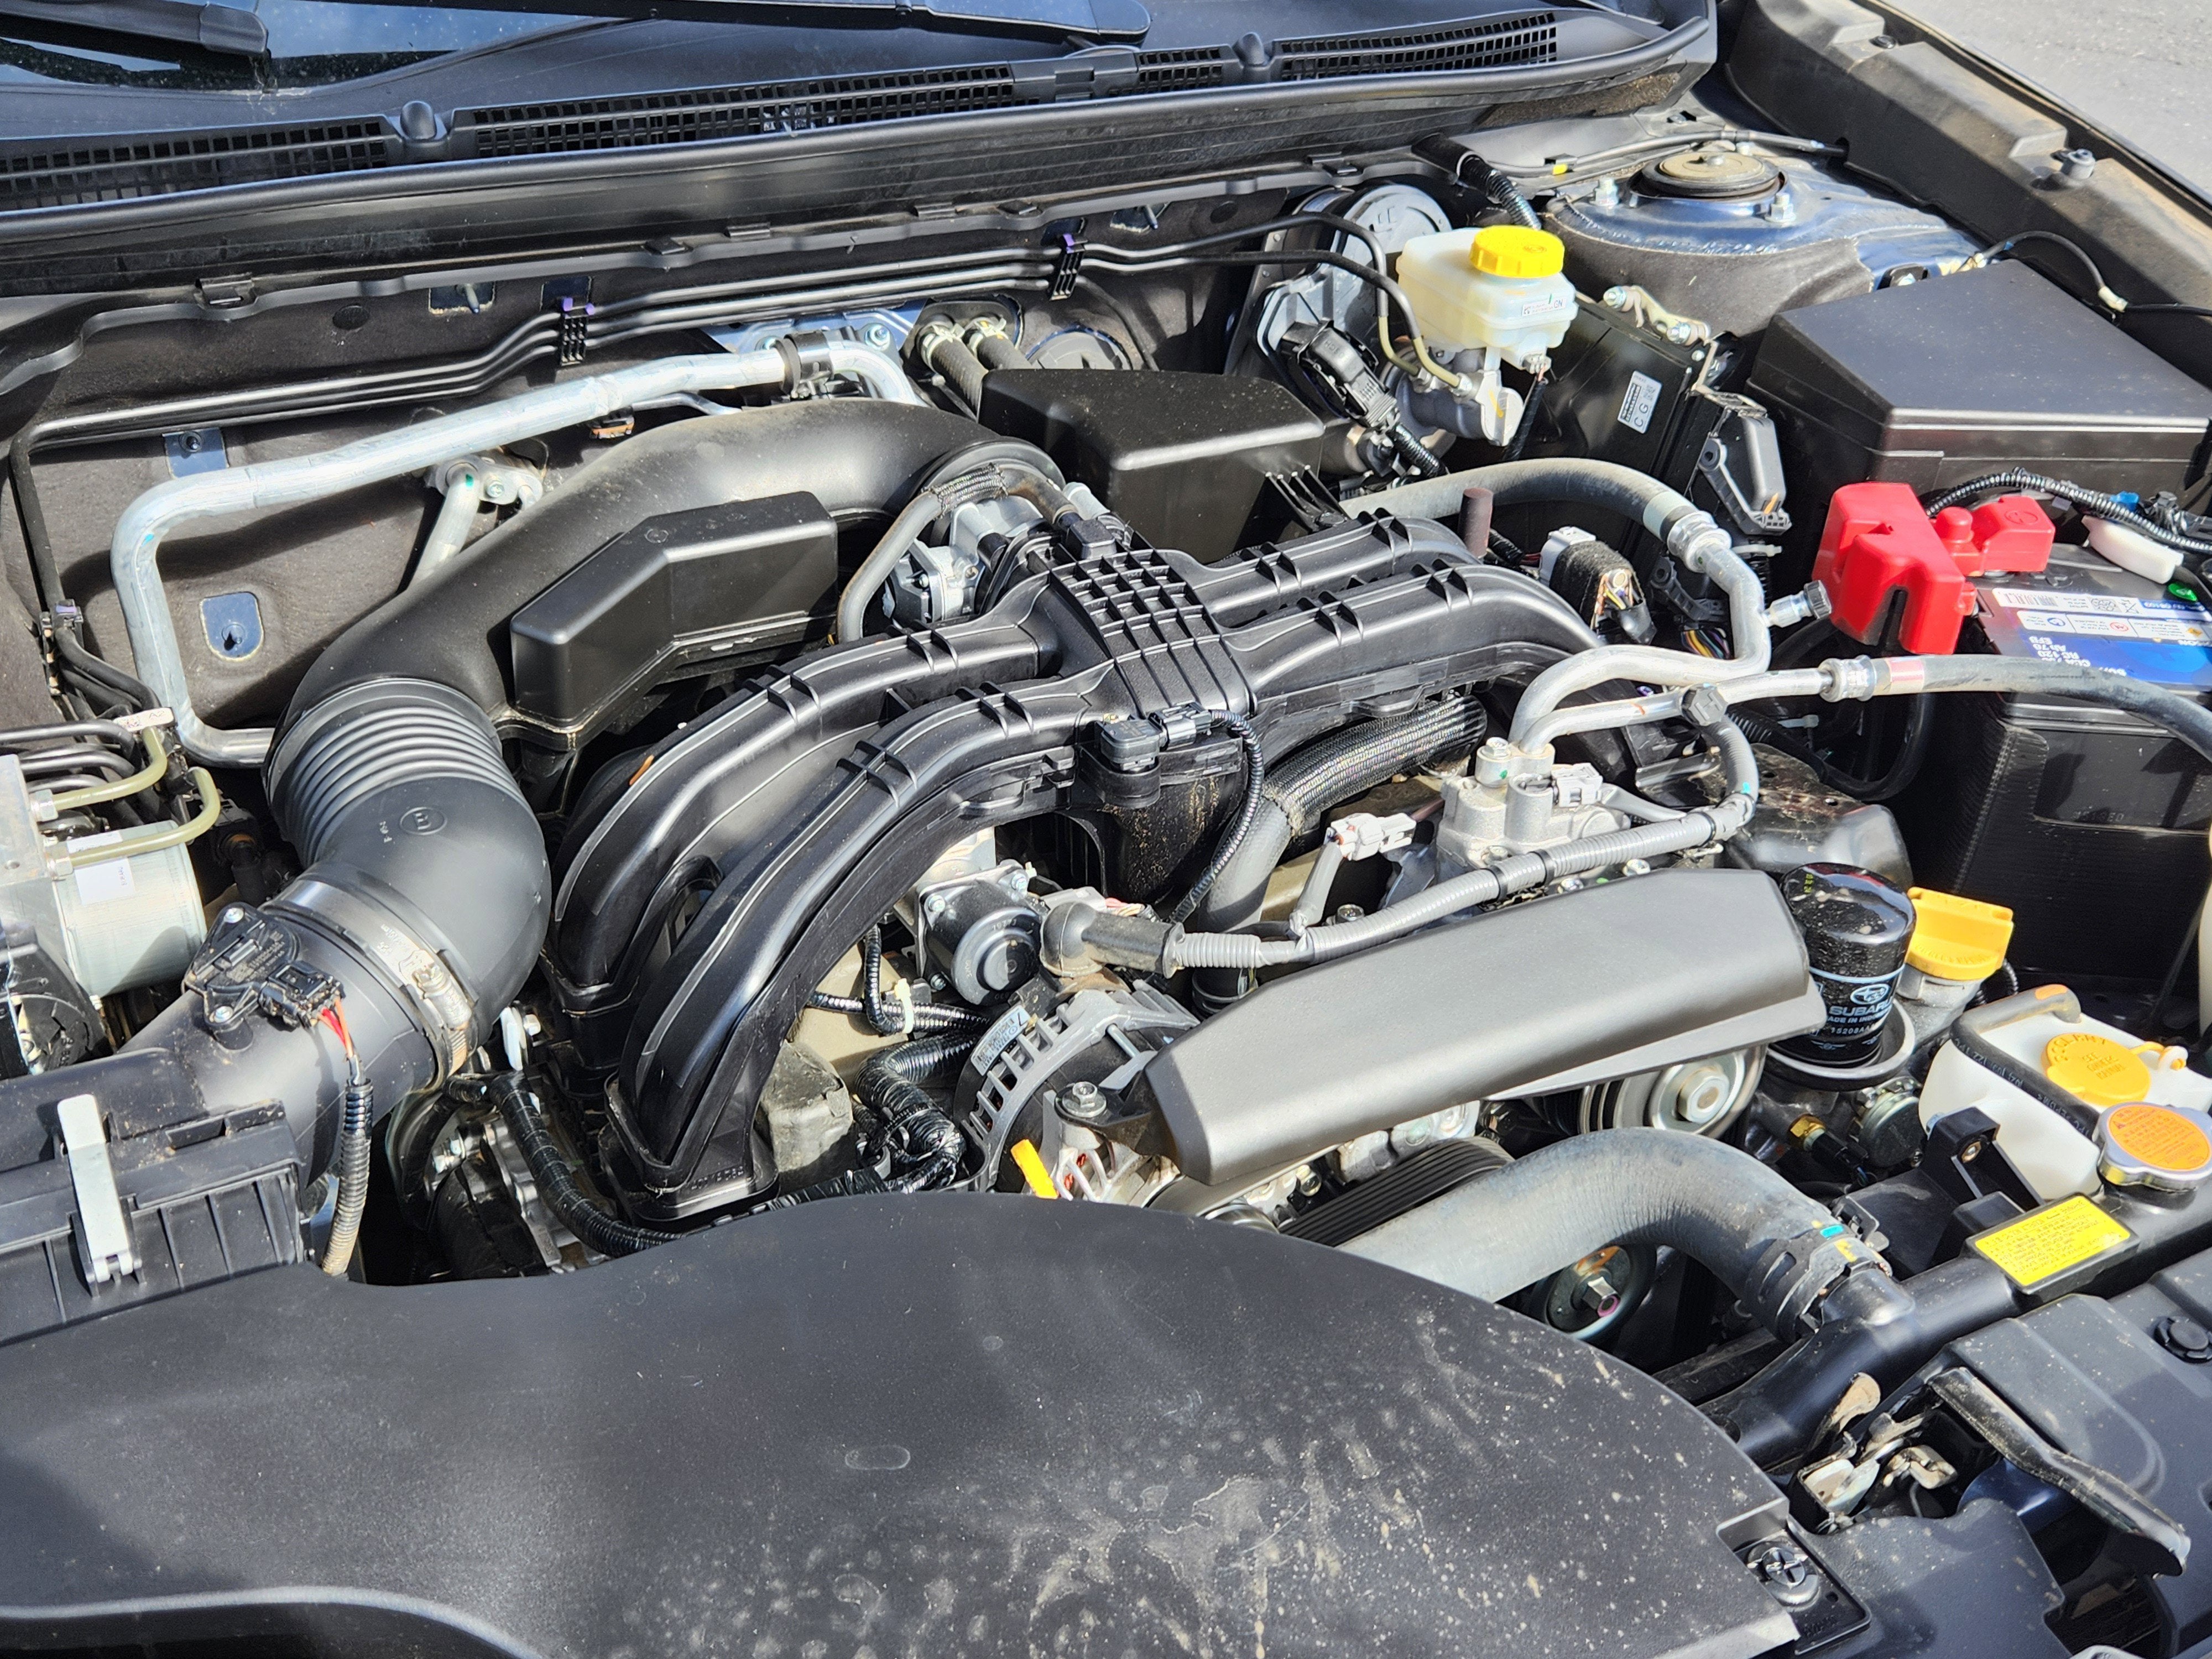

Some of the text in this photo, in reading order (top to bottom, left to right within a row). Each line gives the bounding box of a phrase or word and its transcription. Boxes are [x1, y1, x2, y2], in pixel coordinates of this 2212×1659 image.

[1693, 691, 1724, 721] H
[2052, 1034, 2106, 1063] COOLANT
[2082, 1052, 2098, 1062] SEE
